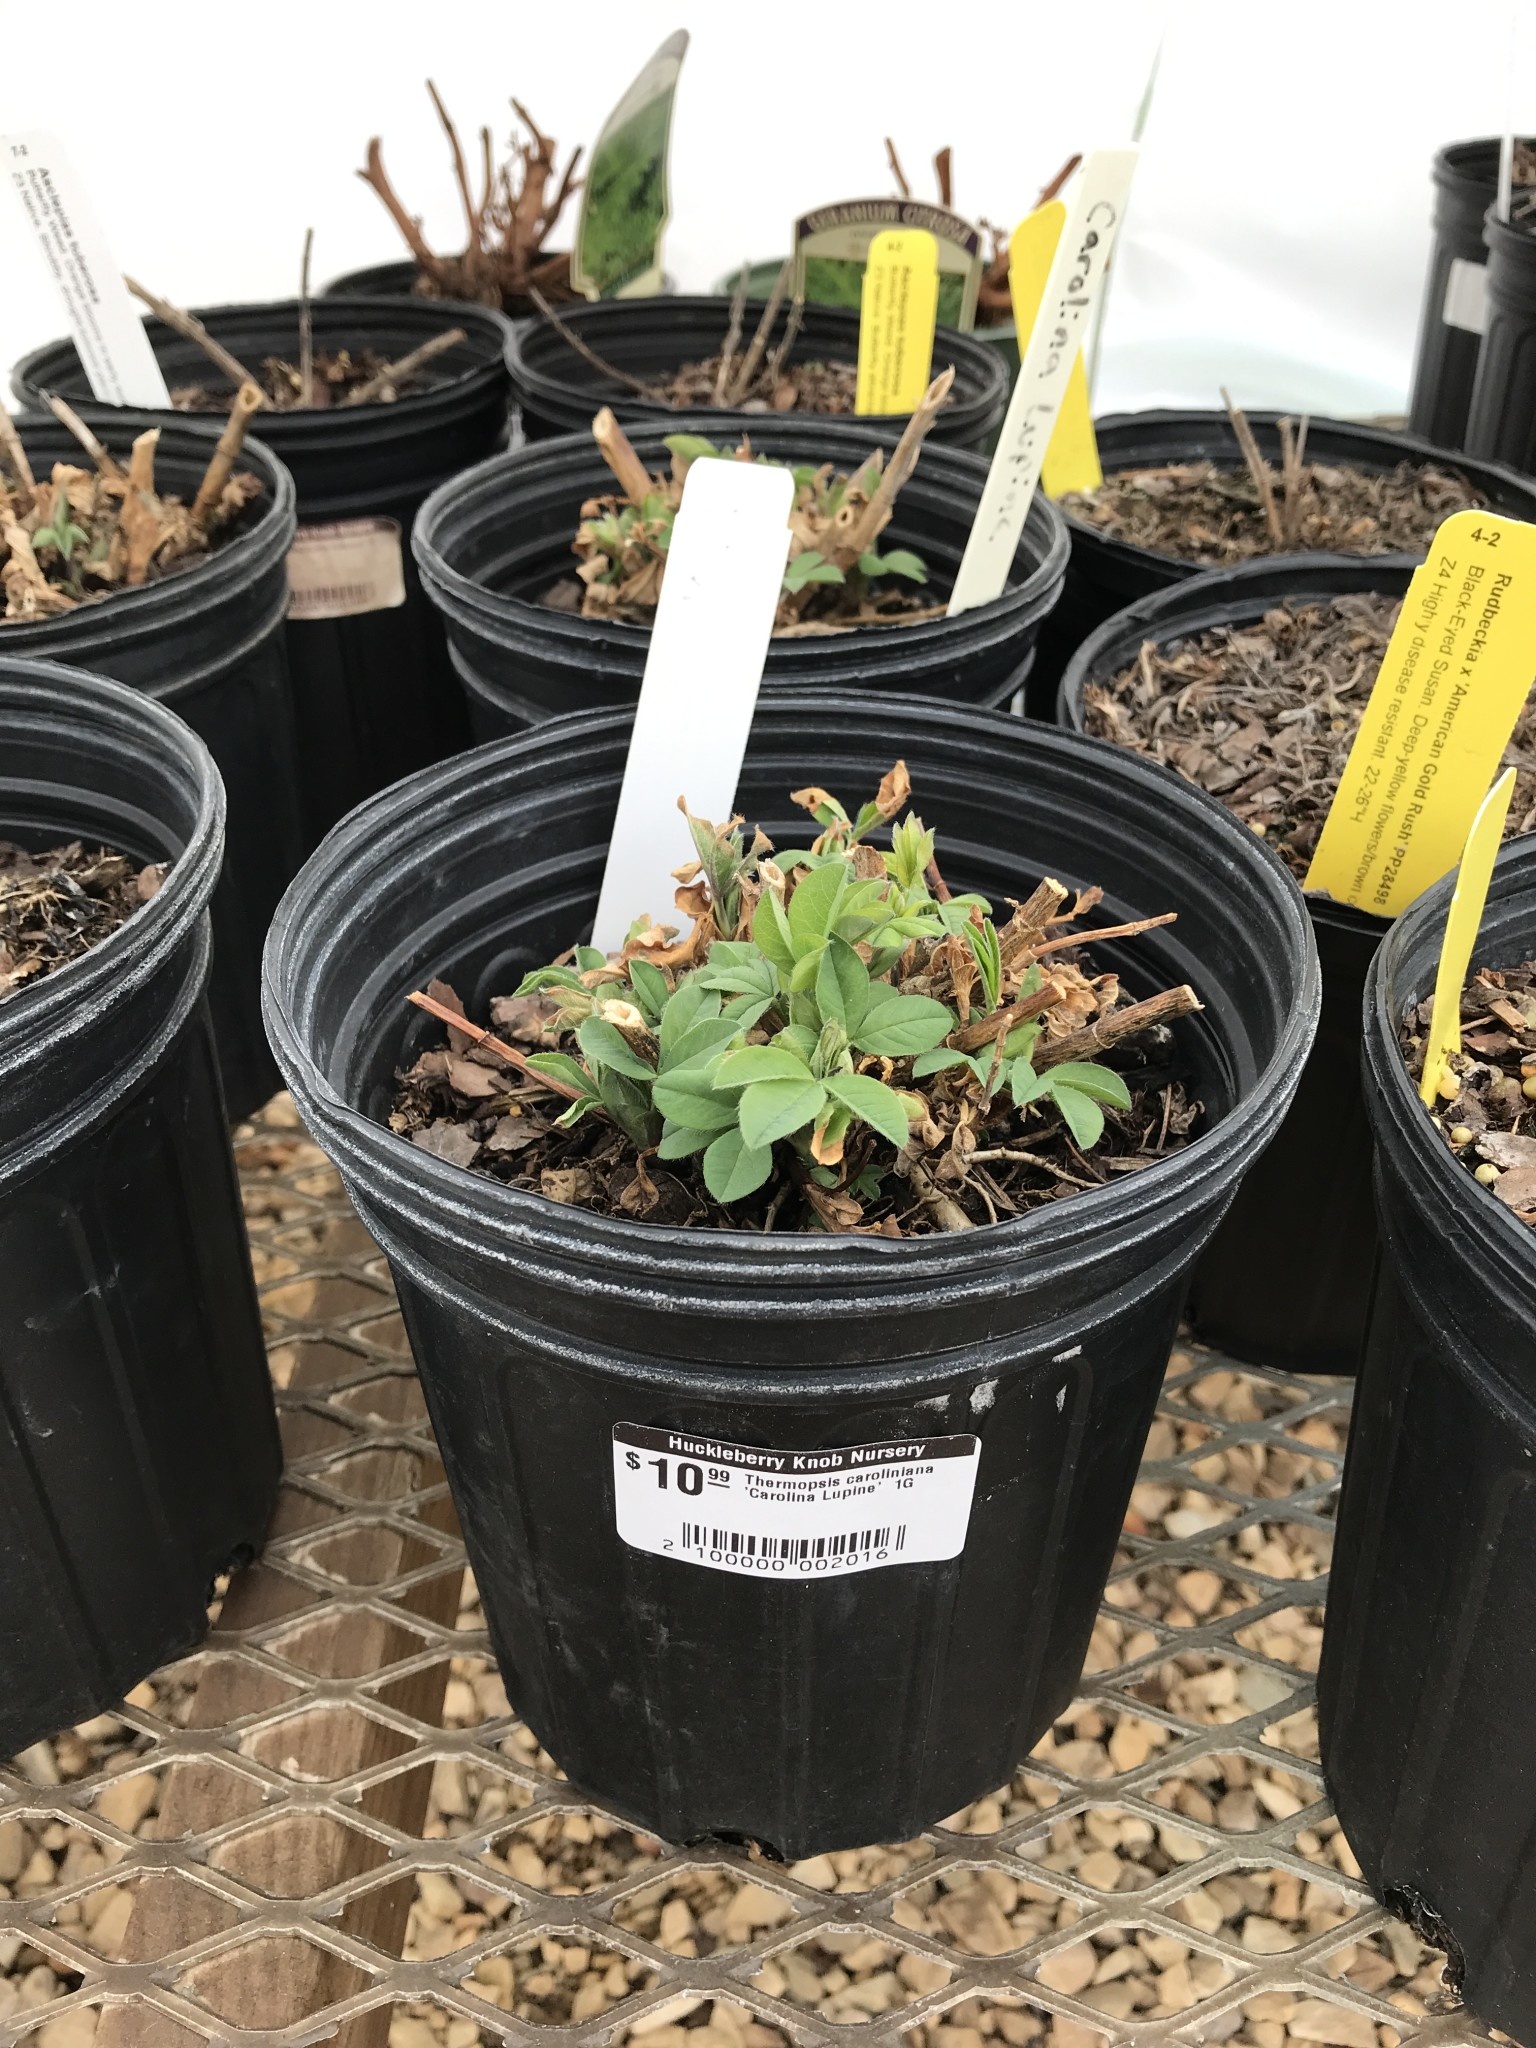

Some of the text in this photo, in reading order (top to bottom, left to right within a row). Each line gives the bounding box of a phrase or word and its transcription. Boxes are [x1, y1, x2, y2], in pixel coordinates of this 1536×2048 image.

[1037, 202, 1116, 378] Carolina
[1470, 527, 1501, 548] 4-2
[1437, 555, 1457, 580] Z4
[1437, 563, 1485, 656] Black-Eyed
[1464, 572, 1512, 664] Rudbeckia
[1393, 635, 1427, 695] disease
[1459, 665, 1472, 677] x
[1384, 713, 1429, 802] Deep-yellow
[1412, 761, 1439, 800] Gold
[1372, 846, 1407, 906] PP28498
[669, 1436, 926, 1470] Huckleberry Knob Nursery
[745, 1465, 934, 1492] Thermopsis caroliniana
[895, 1478, 914, 1490] 1G
[663, 1539, 889, 1571] 2 100000 002016
